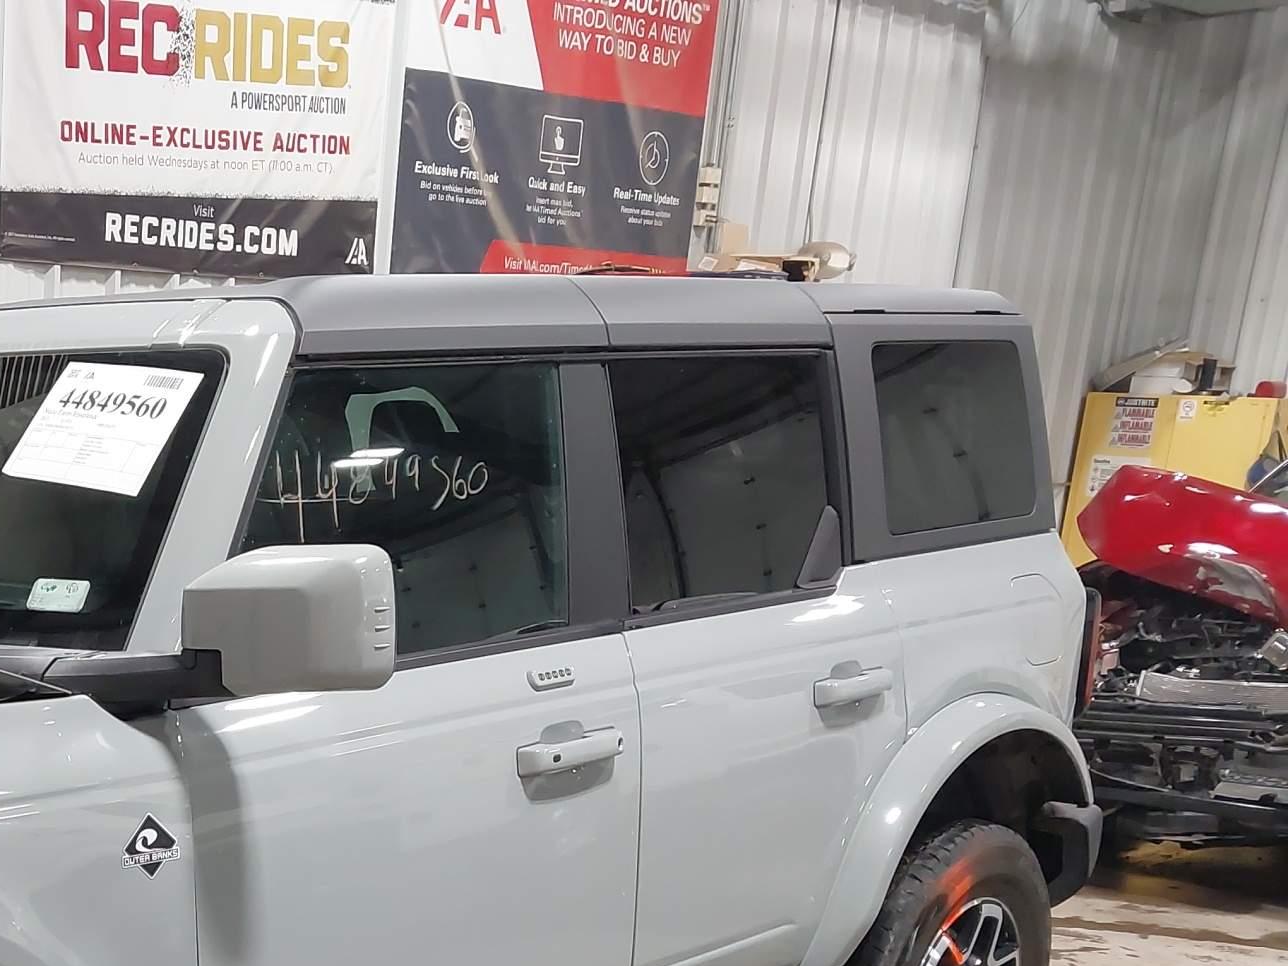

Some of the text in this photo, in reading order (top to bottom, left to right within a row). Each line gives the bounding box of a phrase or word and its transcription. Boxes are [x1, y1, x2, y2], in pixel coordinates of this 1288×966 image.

[553, 2, 692, 47] INTRODUCING A NEW
[559, 29, 681, 68] WAY TO BID & BUY
[230, 90, 347, 116] A POWERSPORT AUCTION
[60, 120, 352, 156] ONLINE-EXCLUSIVE AUCTION
[78, 152, 120, 166] Auction
[122, 154, 144, 167] held
[148, 155, 208, 171] Wednesdays
[210, 160, 220, 169] at
[224, 161, 249, 171] noon
[252, 160, 265, 171] ET
[414, 161, 459, 178] Exclusive
[460, 166, 480, 181] First
[420, 180, 432, 190] Bid
[528, 176, 586, 198] Quick and Easy
[613, 187, 680, 206] Real-Time Updates
[193, 204, 215, 219] Visit
[105, 211, 299, 257] RECRIDES.COM
[504, 255, 522, 271] Visit
[59, 387, 167, 420] 44849560
[124, 849, 178, 866] OUTER BANKS
